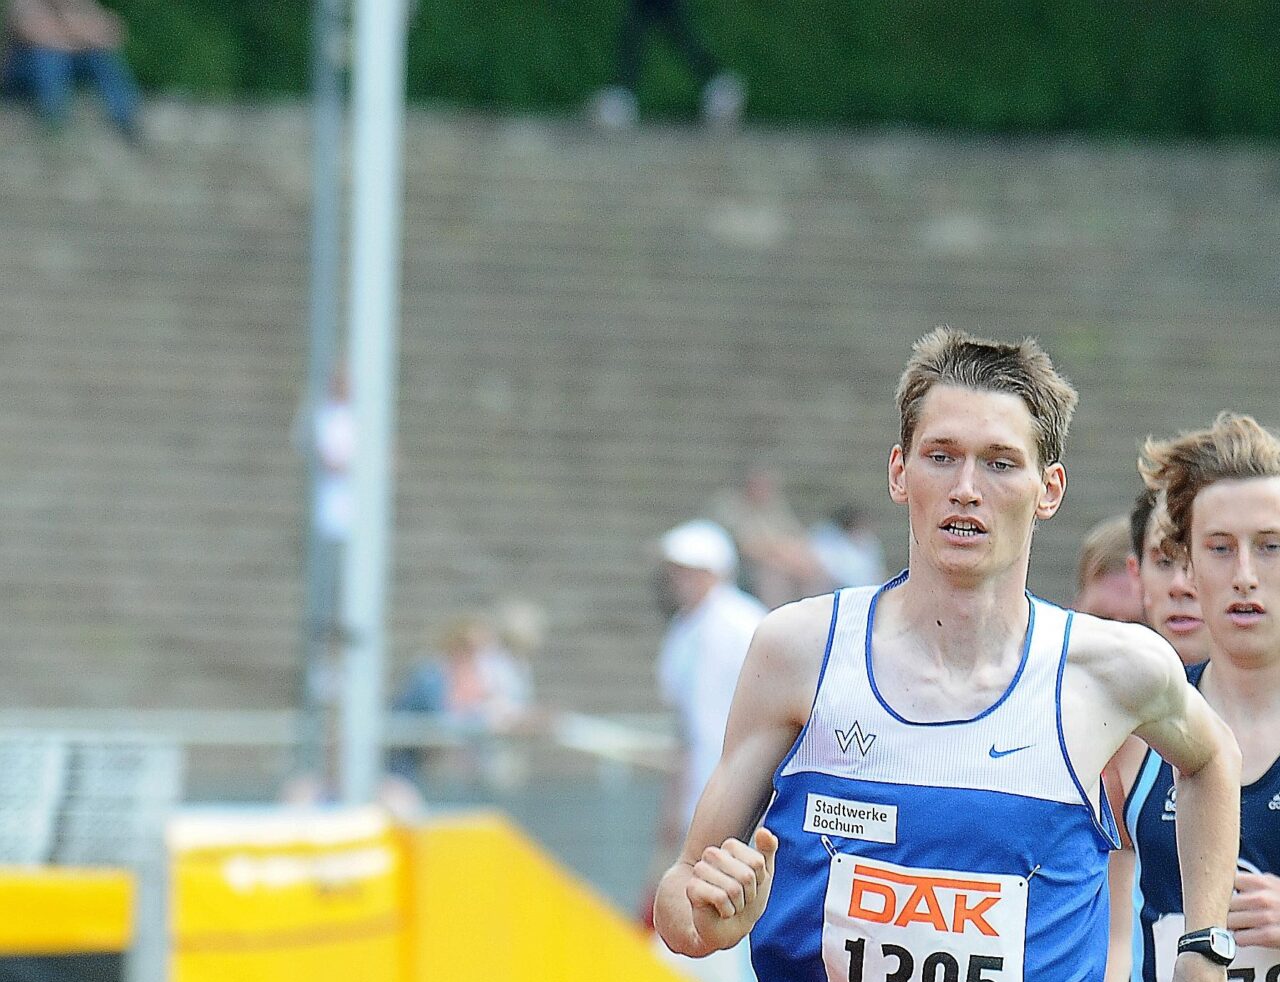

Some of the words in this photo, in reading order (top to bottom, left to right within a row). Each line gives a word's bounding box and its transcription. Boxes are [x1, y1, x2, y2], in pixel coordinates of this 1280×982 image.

[815, 799, 888, 822] Stadtwerke
[812, 814, 865, 835] Bochum
[848, 864, 1002, 937] DAK
